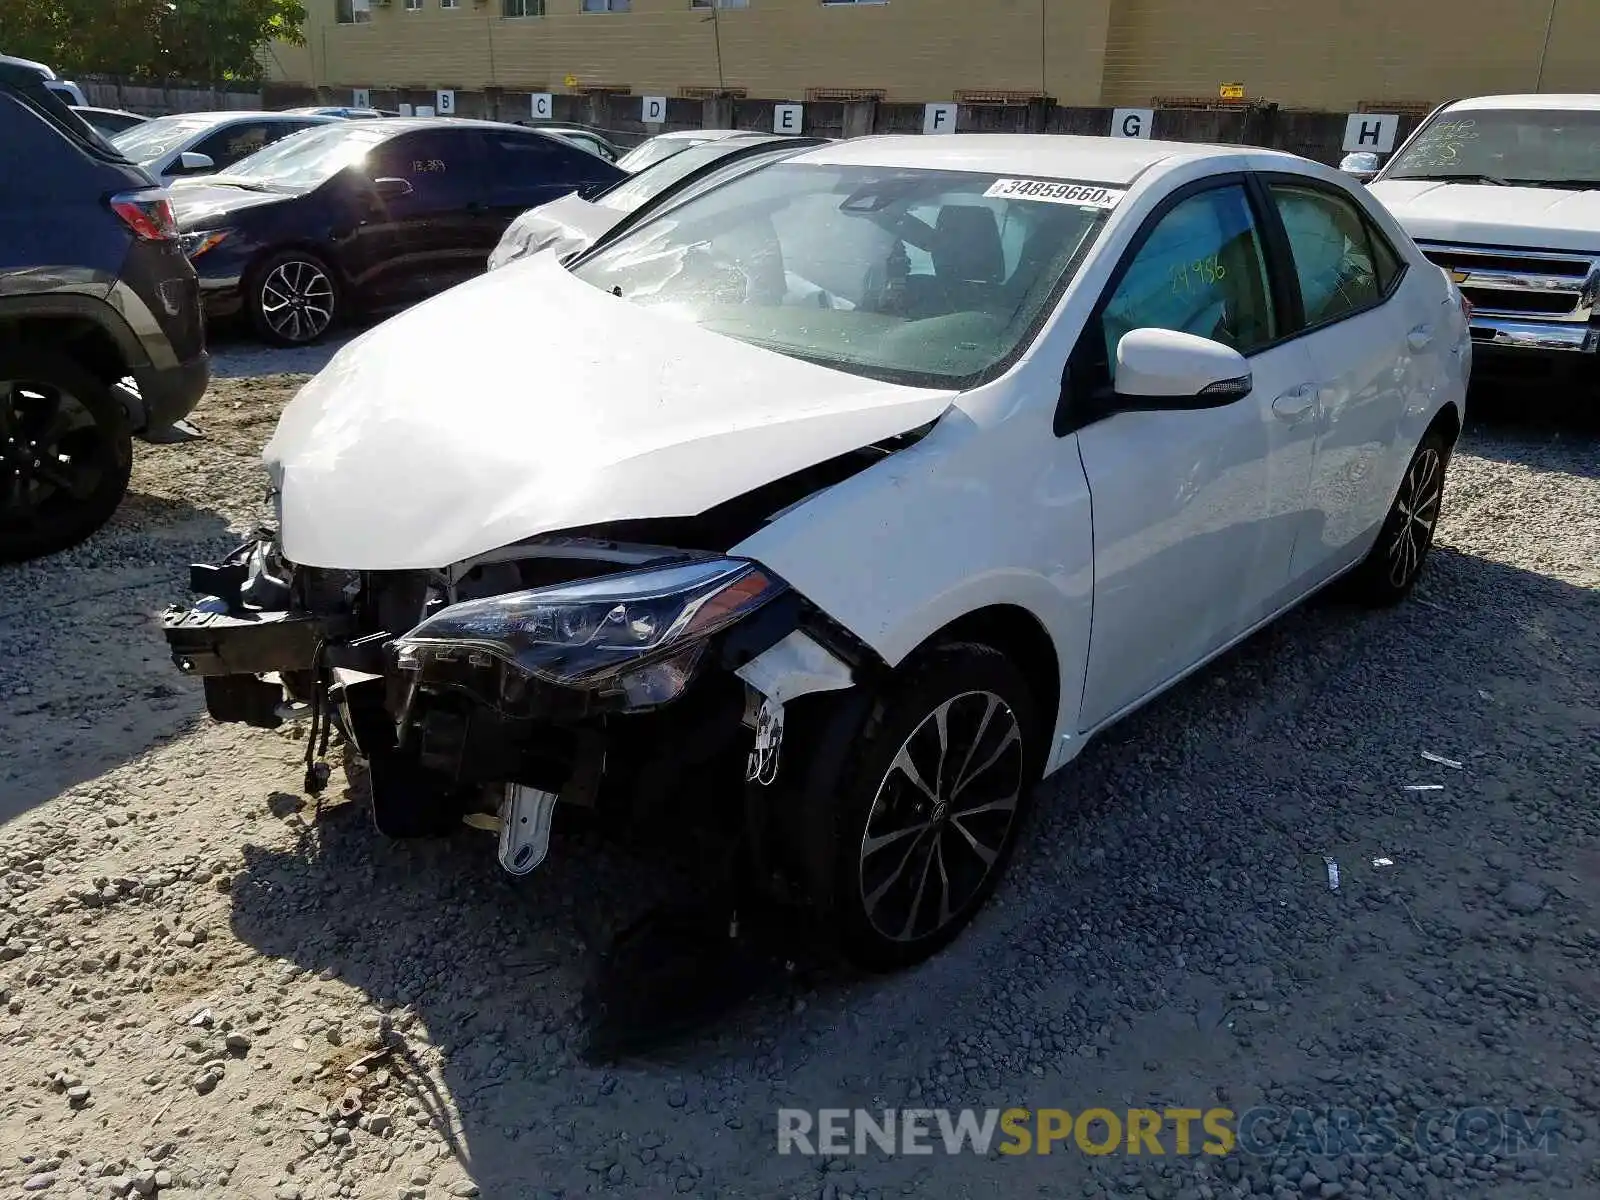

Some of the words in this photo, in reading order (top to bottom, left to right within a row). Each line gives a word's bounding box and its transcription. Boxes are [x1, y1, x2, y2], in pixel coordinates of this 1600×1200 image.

[442, 95, 450, 108] B
[537, 98, 546, 114] C
[650, 102, 660, 118] D
[782, 110, 793, 128] E
[934, 110, 946, 129] F
[1122, 114, 1141, 137] G
[1358, 121, 1382, 145] H
[1004, 181, 1108, 202] 34859660
